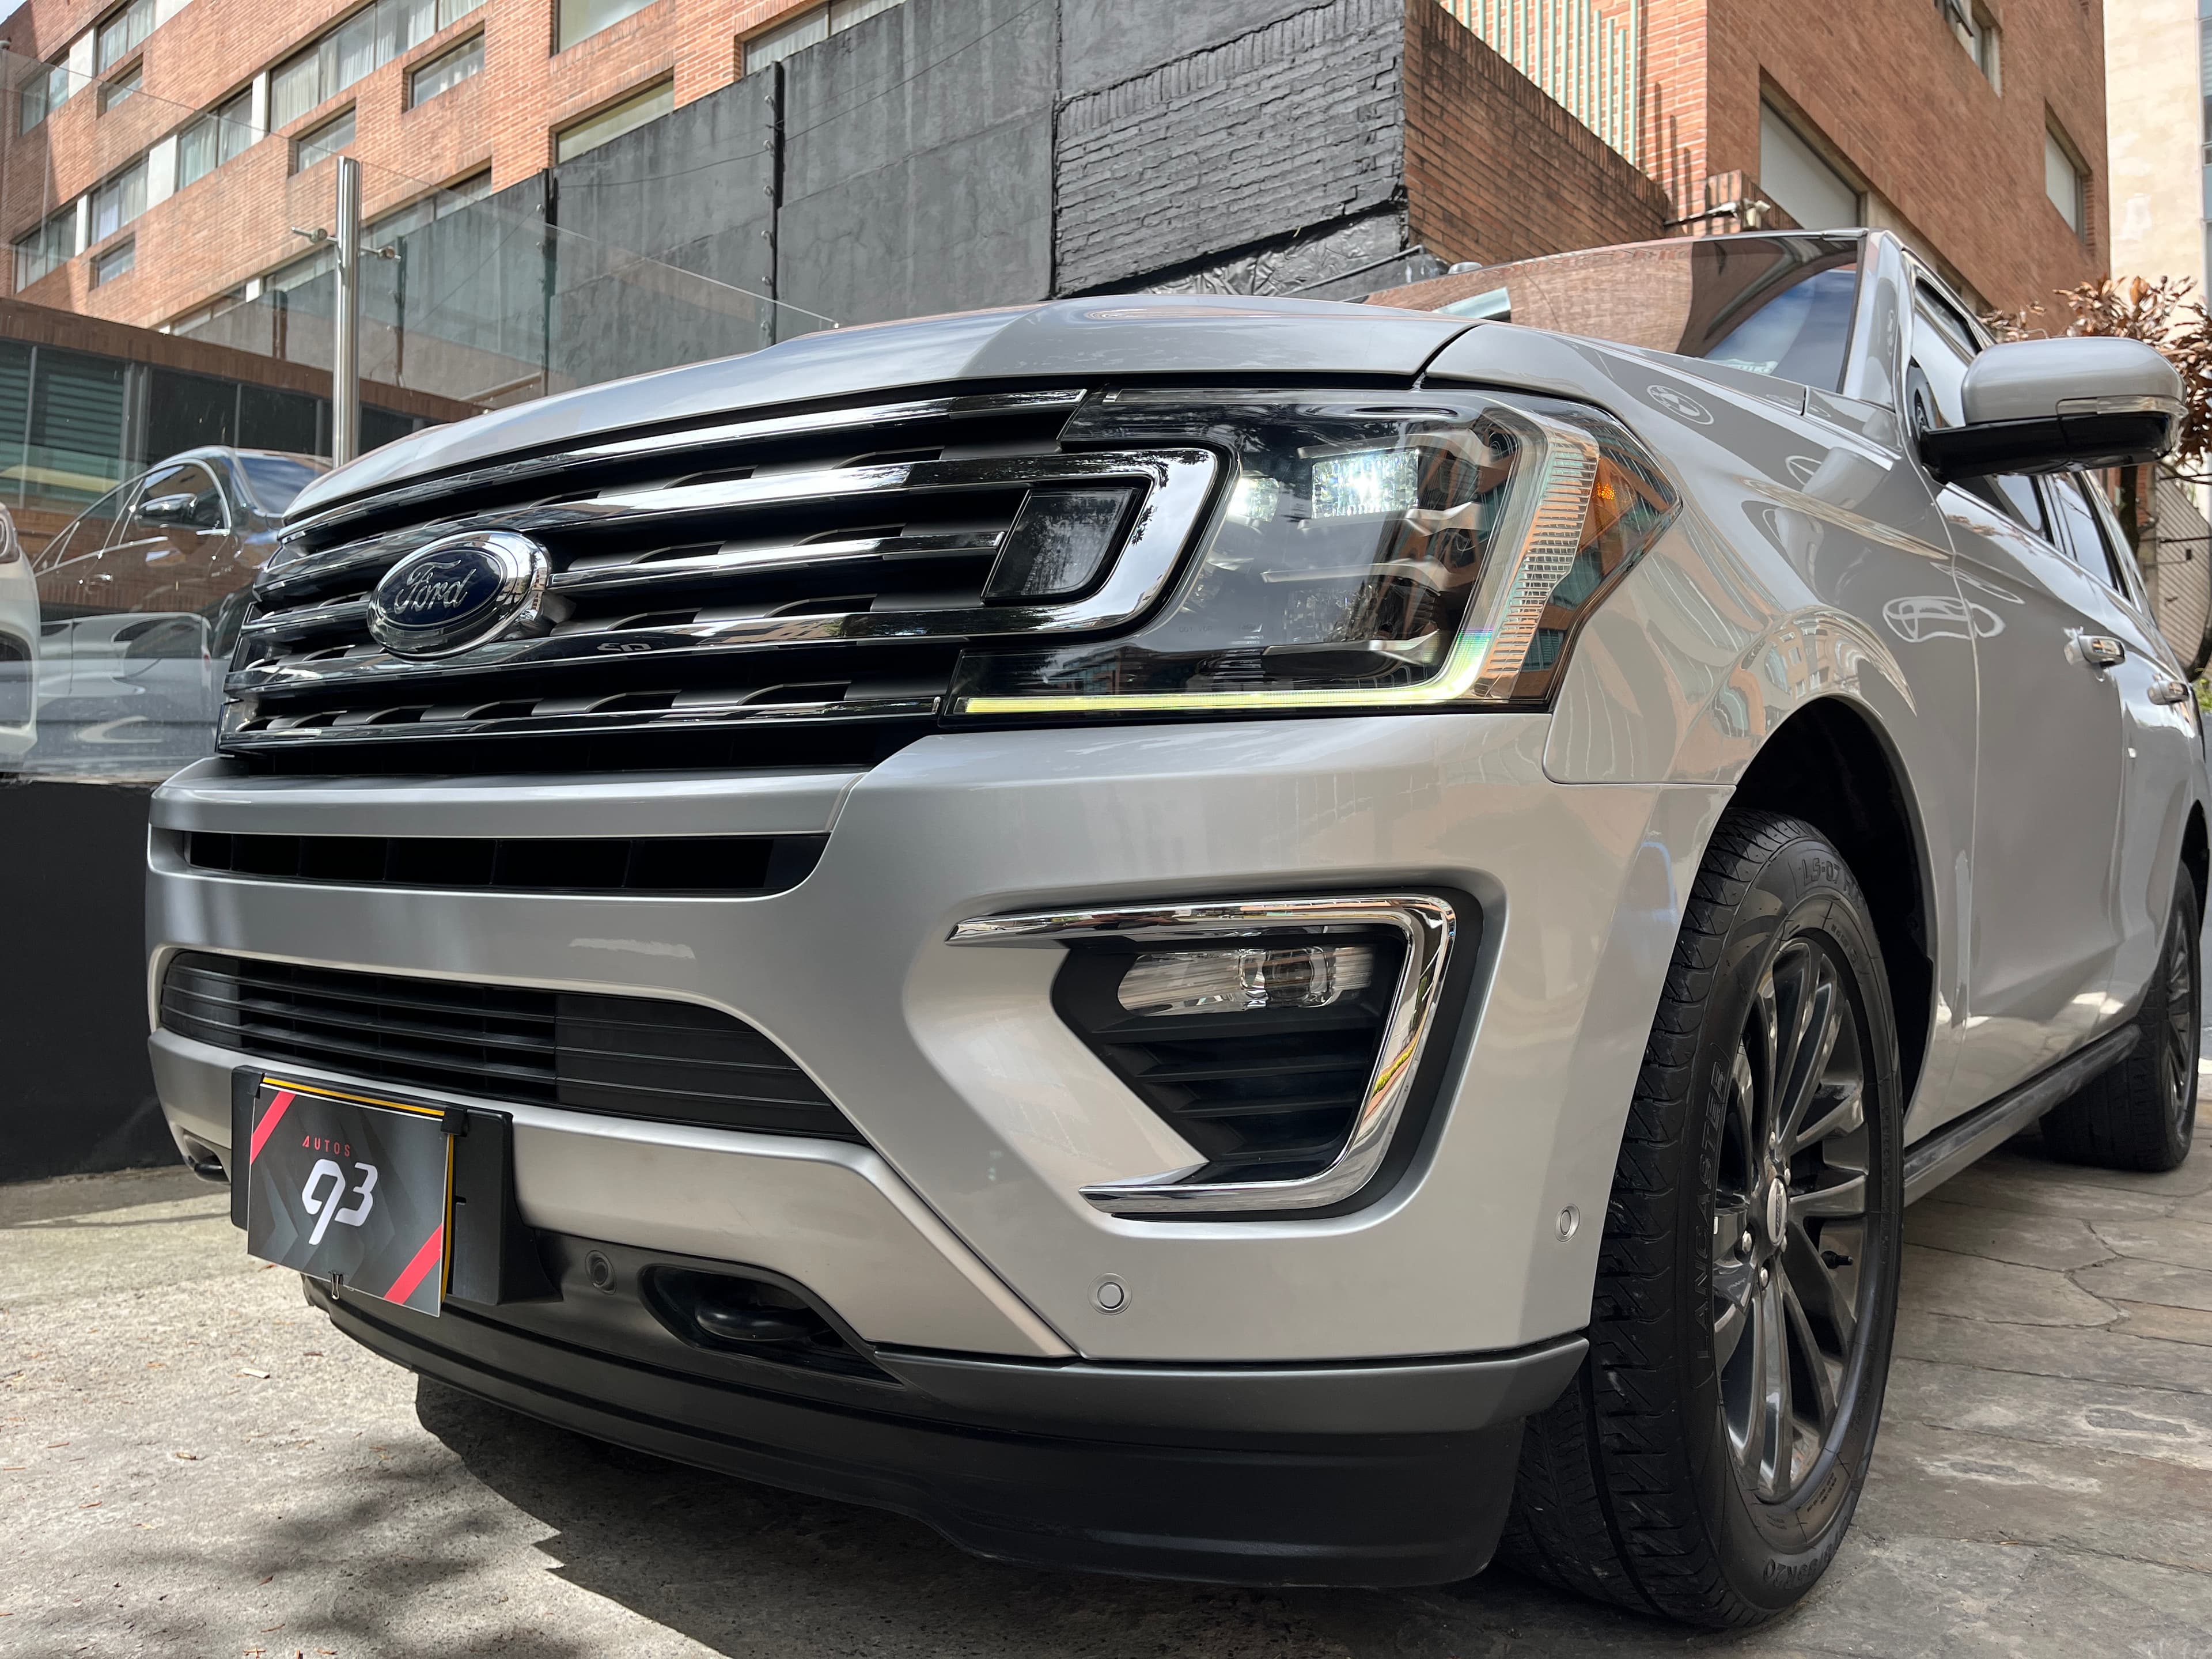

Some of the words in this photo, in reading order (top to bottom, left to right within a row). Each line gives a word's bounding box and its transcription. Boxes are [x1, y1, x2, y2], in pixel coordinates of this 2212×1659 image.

[394, 559, 476, 615] Ford
[302, 1135, 351, 1157] AUTOS
[302, 1158, 378, 1245] 93
[1695, 1061, 1728, 1358] LANCASTER
